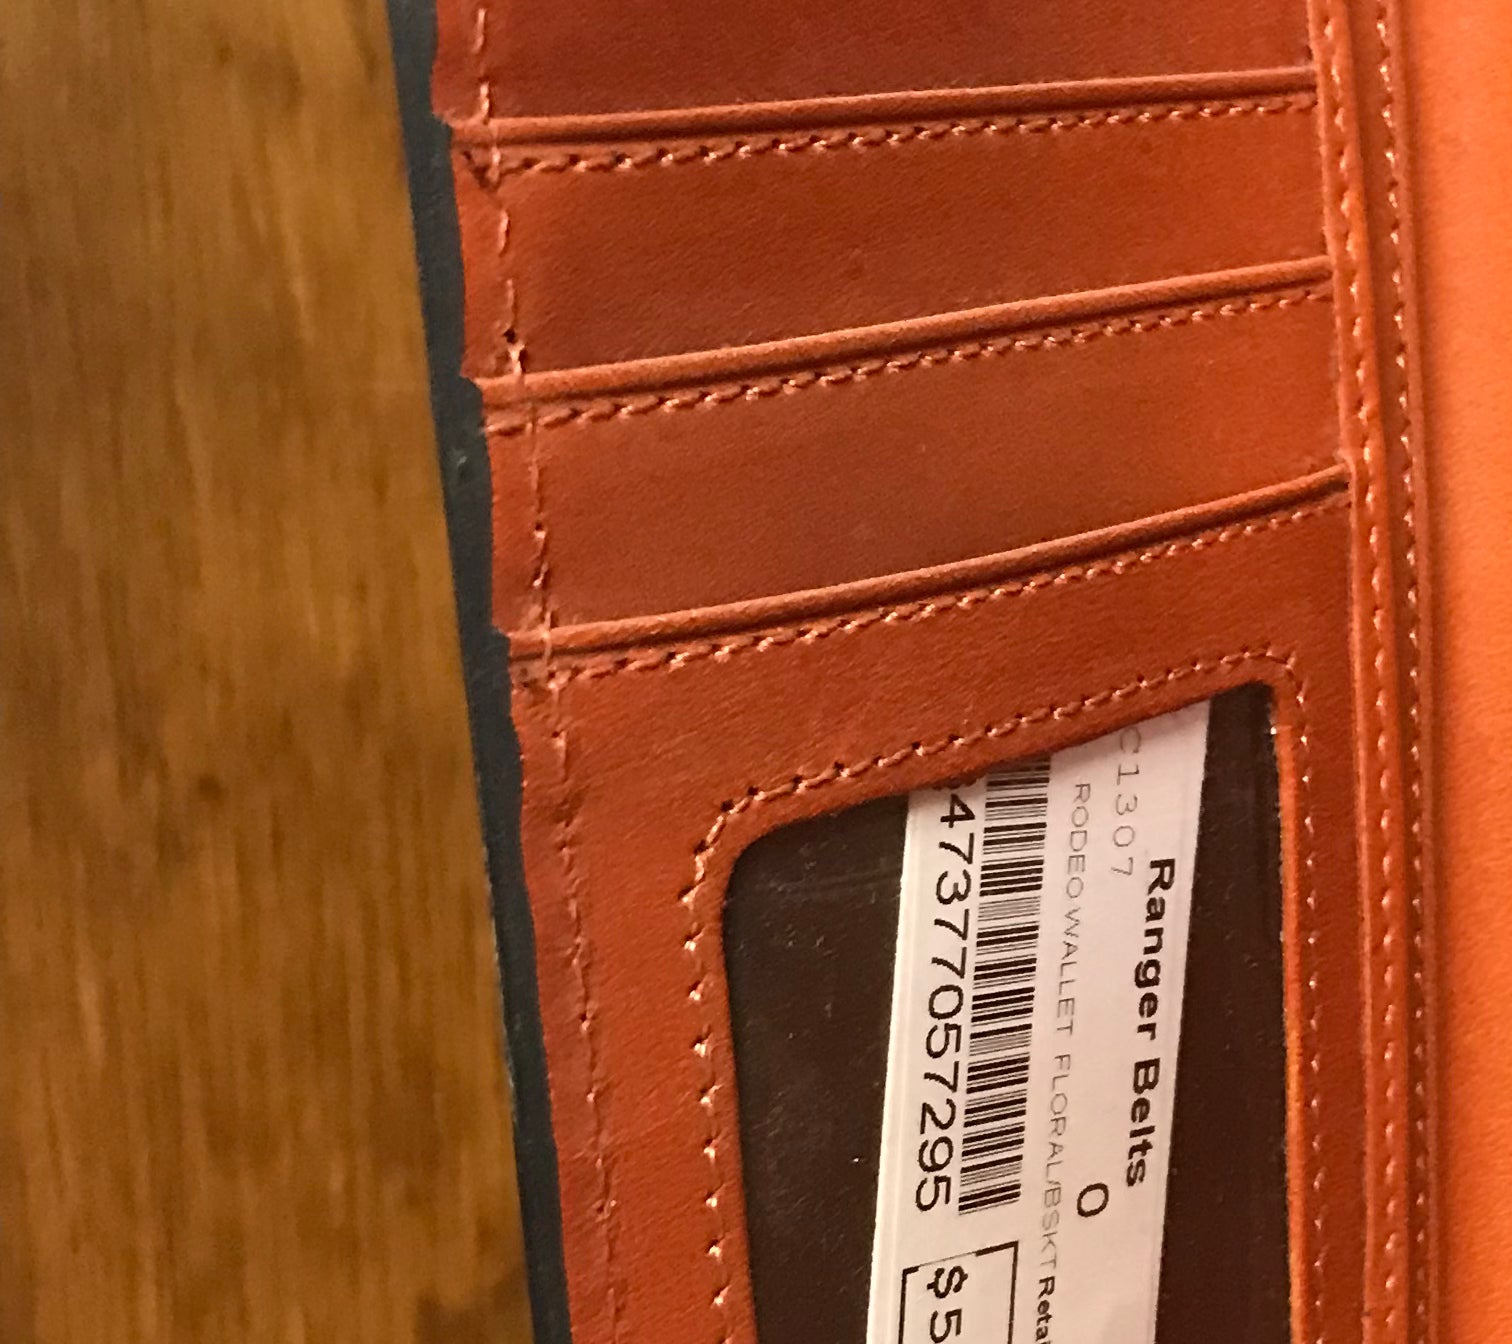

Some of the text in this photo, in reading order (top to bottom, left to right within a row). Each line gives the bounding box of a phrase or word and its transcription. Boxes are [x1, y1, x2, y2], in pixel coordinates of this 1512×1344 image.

[1110, 726, 1142, 876] C1307
[915, 784, 975, 1212] 47377057295
[1037, 783, 1091, 1269] RODEO WALLET FLORAL/BSKT
[1126, 858, 1175, 1188] Ranger Belts
